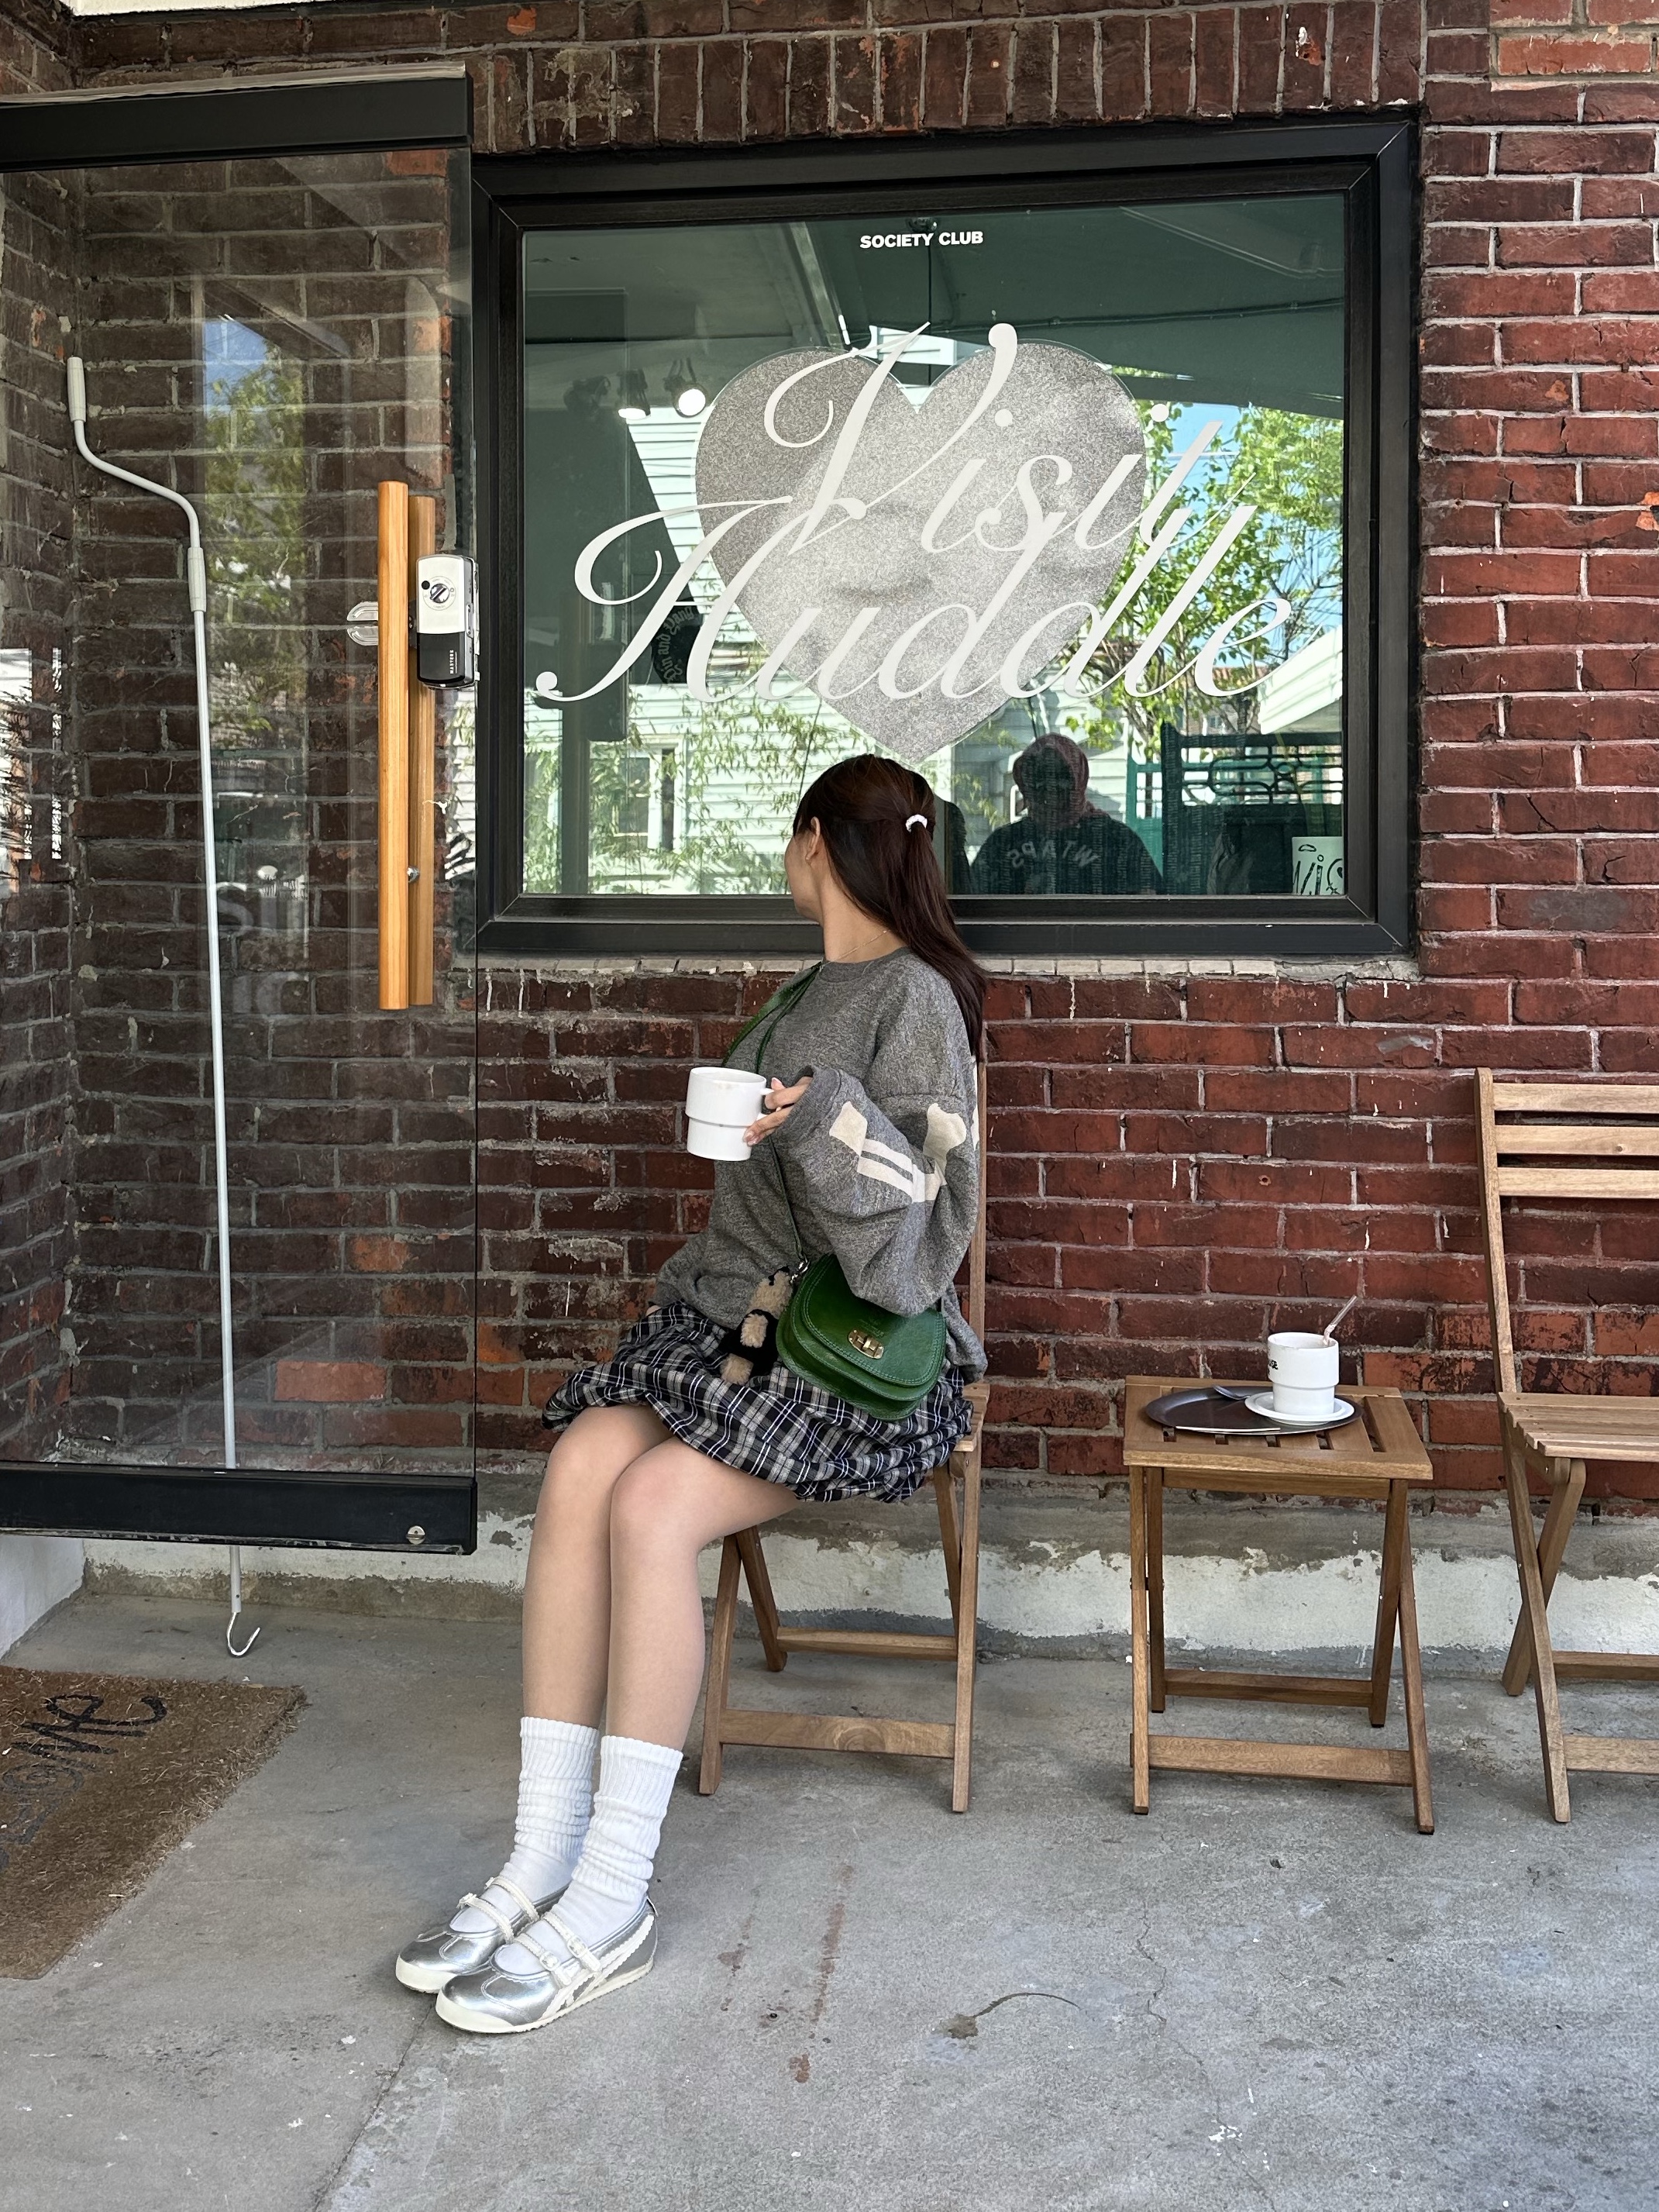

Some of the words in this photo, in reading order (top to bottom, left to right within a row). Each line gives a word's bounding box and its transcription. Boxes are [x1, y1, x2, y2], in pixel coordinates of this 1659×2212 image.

[859, 233, 934, 249] SOCIETY
[938, 230, 984, 246] CLUB
[535, 494, 1322, 703] Huddle
